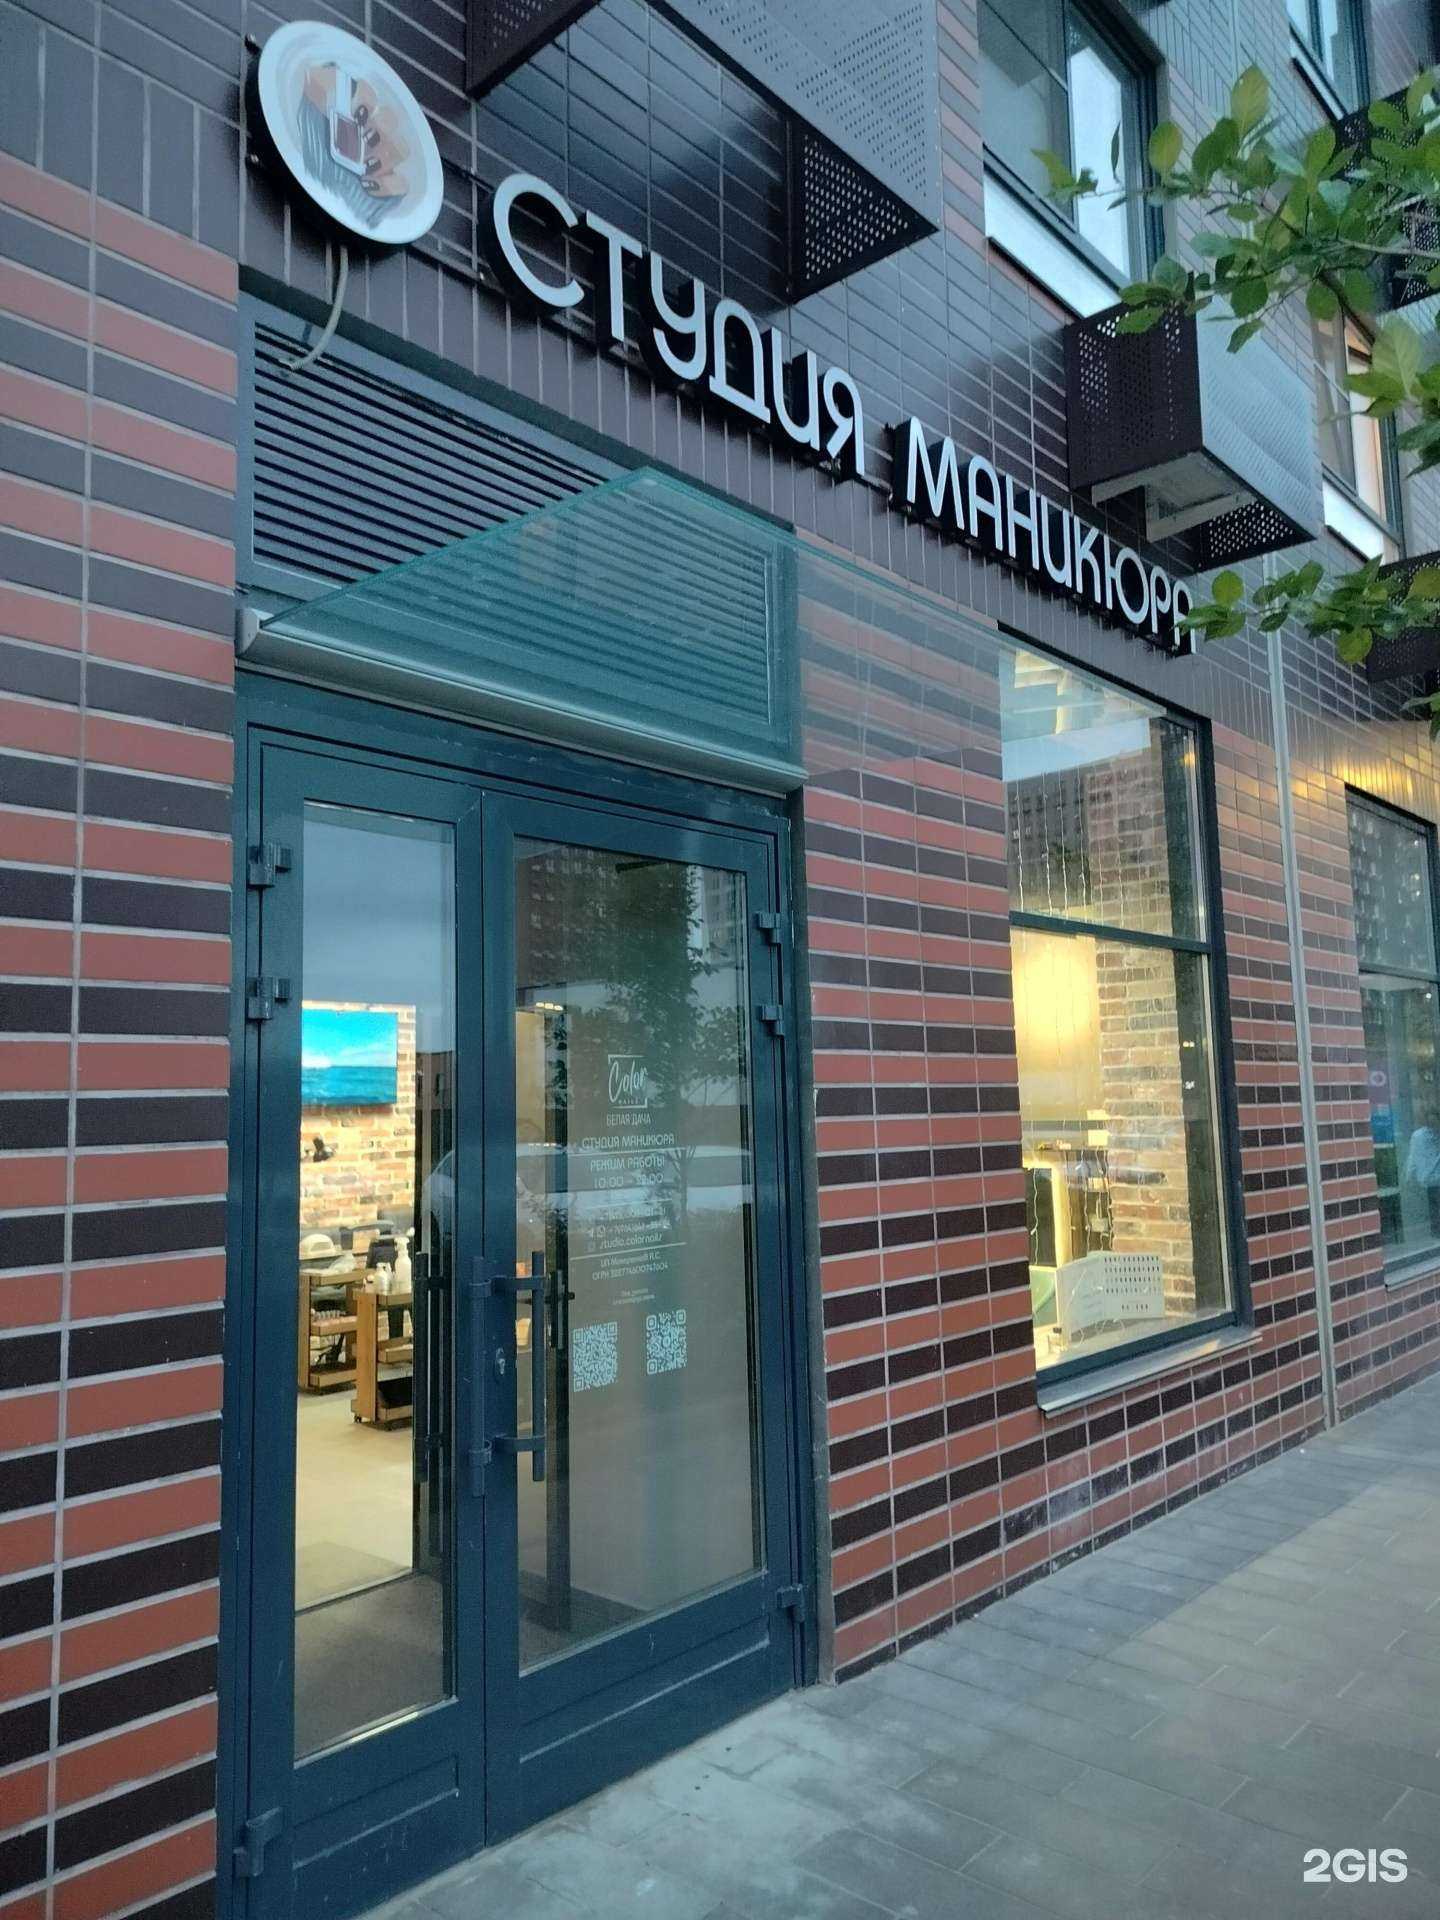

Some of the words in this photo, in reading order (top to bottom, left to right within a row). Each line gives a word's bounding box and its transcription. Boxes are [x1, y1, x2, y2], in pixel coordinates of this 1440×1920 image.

[493, 173, 866, 477] СТУДИЯ
[906, 416, 1197, 654] МАНИКЮРА
[608, 1060, 649, 1103] Color
[606, 1113, 631, 1127] БЕЛАЯ
[581, 1136, 620, 1150] СТУДИЯ
[622, 1133, 675, 1148] МАНИКЮРА
[590, 1157, 625, 1172] РЕЖИМ
[627, 1154, 665, 1169] РАБОТЫ
